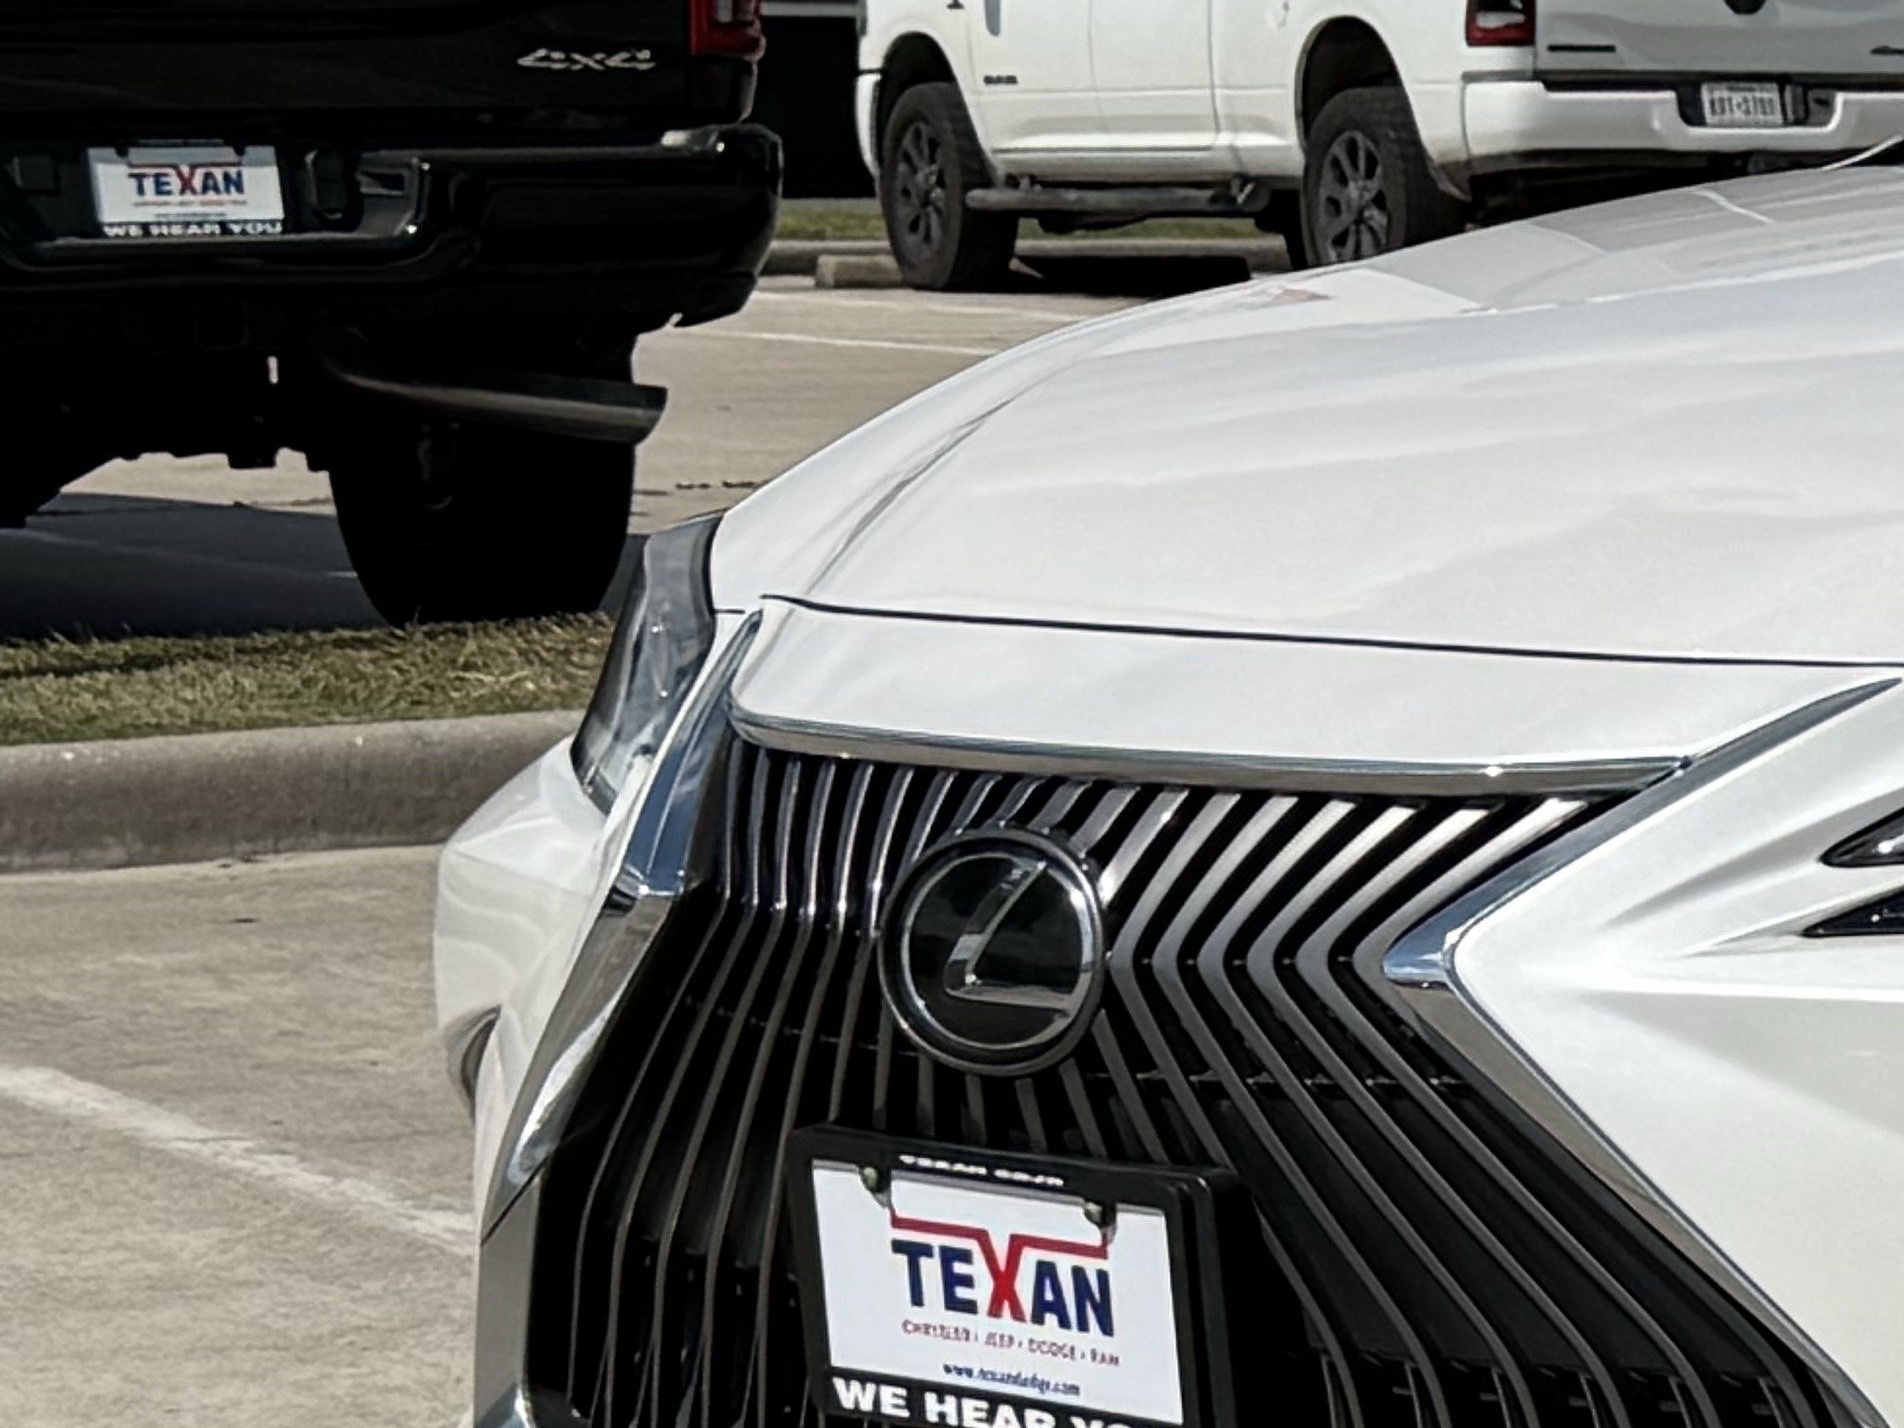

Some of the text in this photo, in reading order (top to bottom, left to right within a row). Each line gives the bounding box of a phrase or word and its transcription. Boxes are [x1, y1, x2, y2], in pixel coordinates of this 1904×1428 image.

[127, 163, 245, 197] TEXAN
[103, 220, 283, 237] WE HEAR YOU
[890, 1215, 1116, 1338] TEXAN
[1028, 1337, 1076, 1361] DODGE
[832, 1376, 910, 1420] WE
